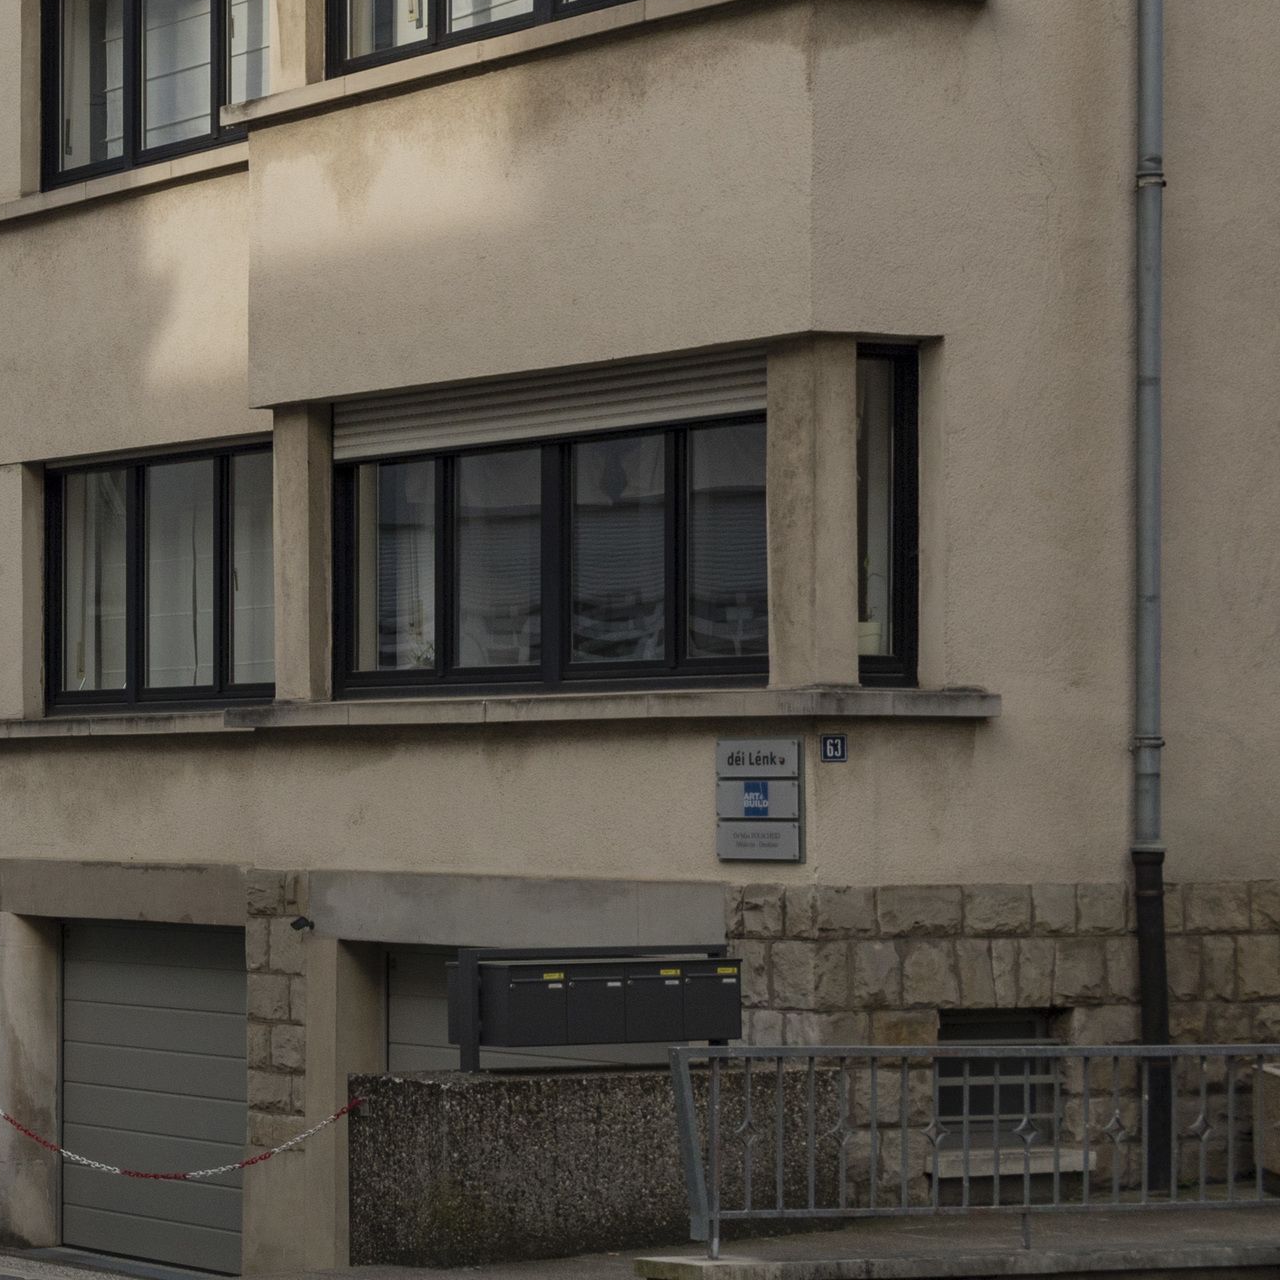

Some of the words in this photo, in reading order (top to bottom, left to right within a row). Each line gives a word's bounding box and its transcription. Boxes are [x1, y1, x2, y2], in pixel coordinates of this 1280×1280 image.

[826, 739, 841, 757] 63
[727, 750, 745, 766] déi
[749, 750, 777, 766] Lénk
[744, 800, 768, 808] BUILD
